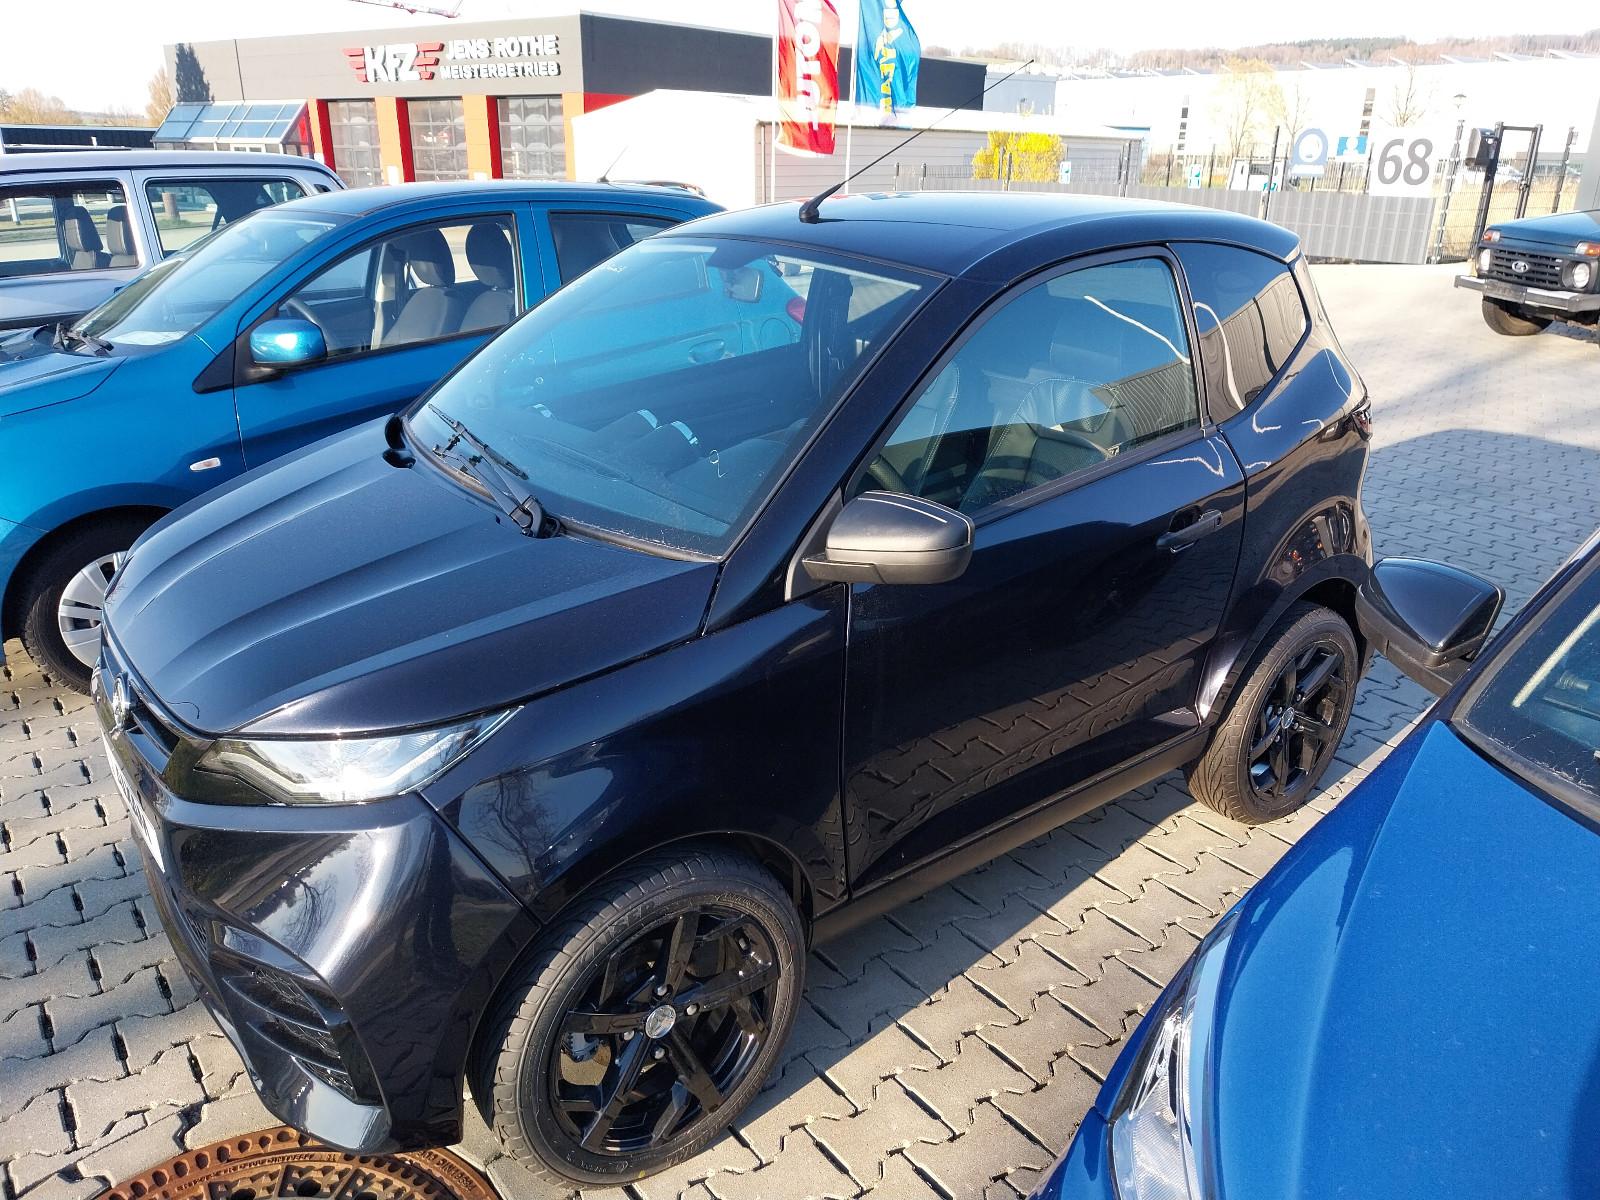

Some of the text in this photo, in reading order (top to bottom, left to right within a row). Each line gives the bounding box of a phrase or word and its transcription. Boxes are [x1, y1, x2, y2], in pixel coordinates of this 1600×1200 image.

[364, 43, 420, 82] KFZ
[446, 34, 559, 60] JENS ROTHE
[440, 61, 560, 80] MEISTERBETRIEB
[1378, 138, 1433, 186] 68
